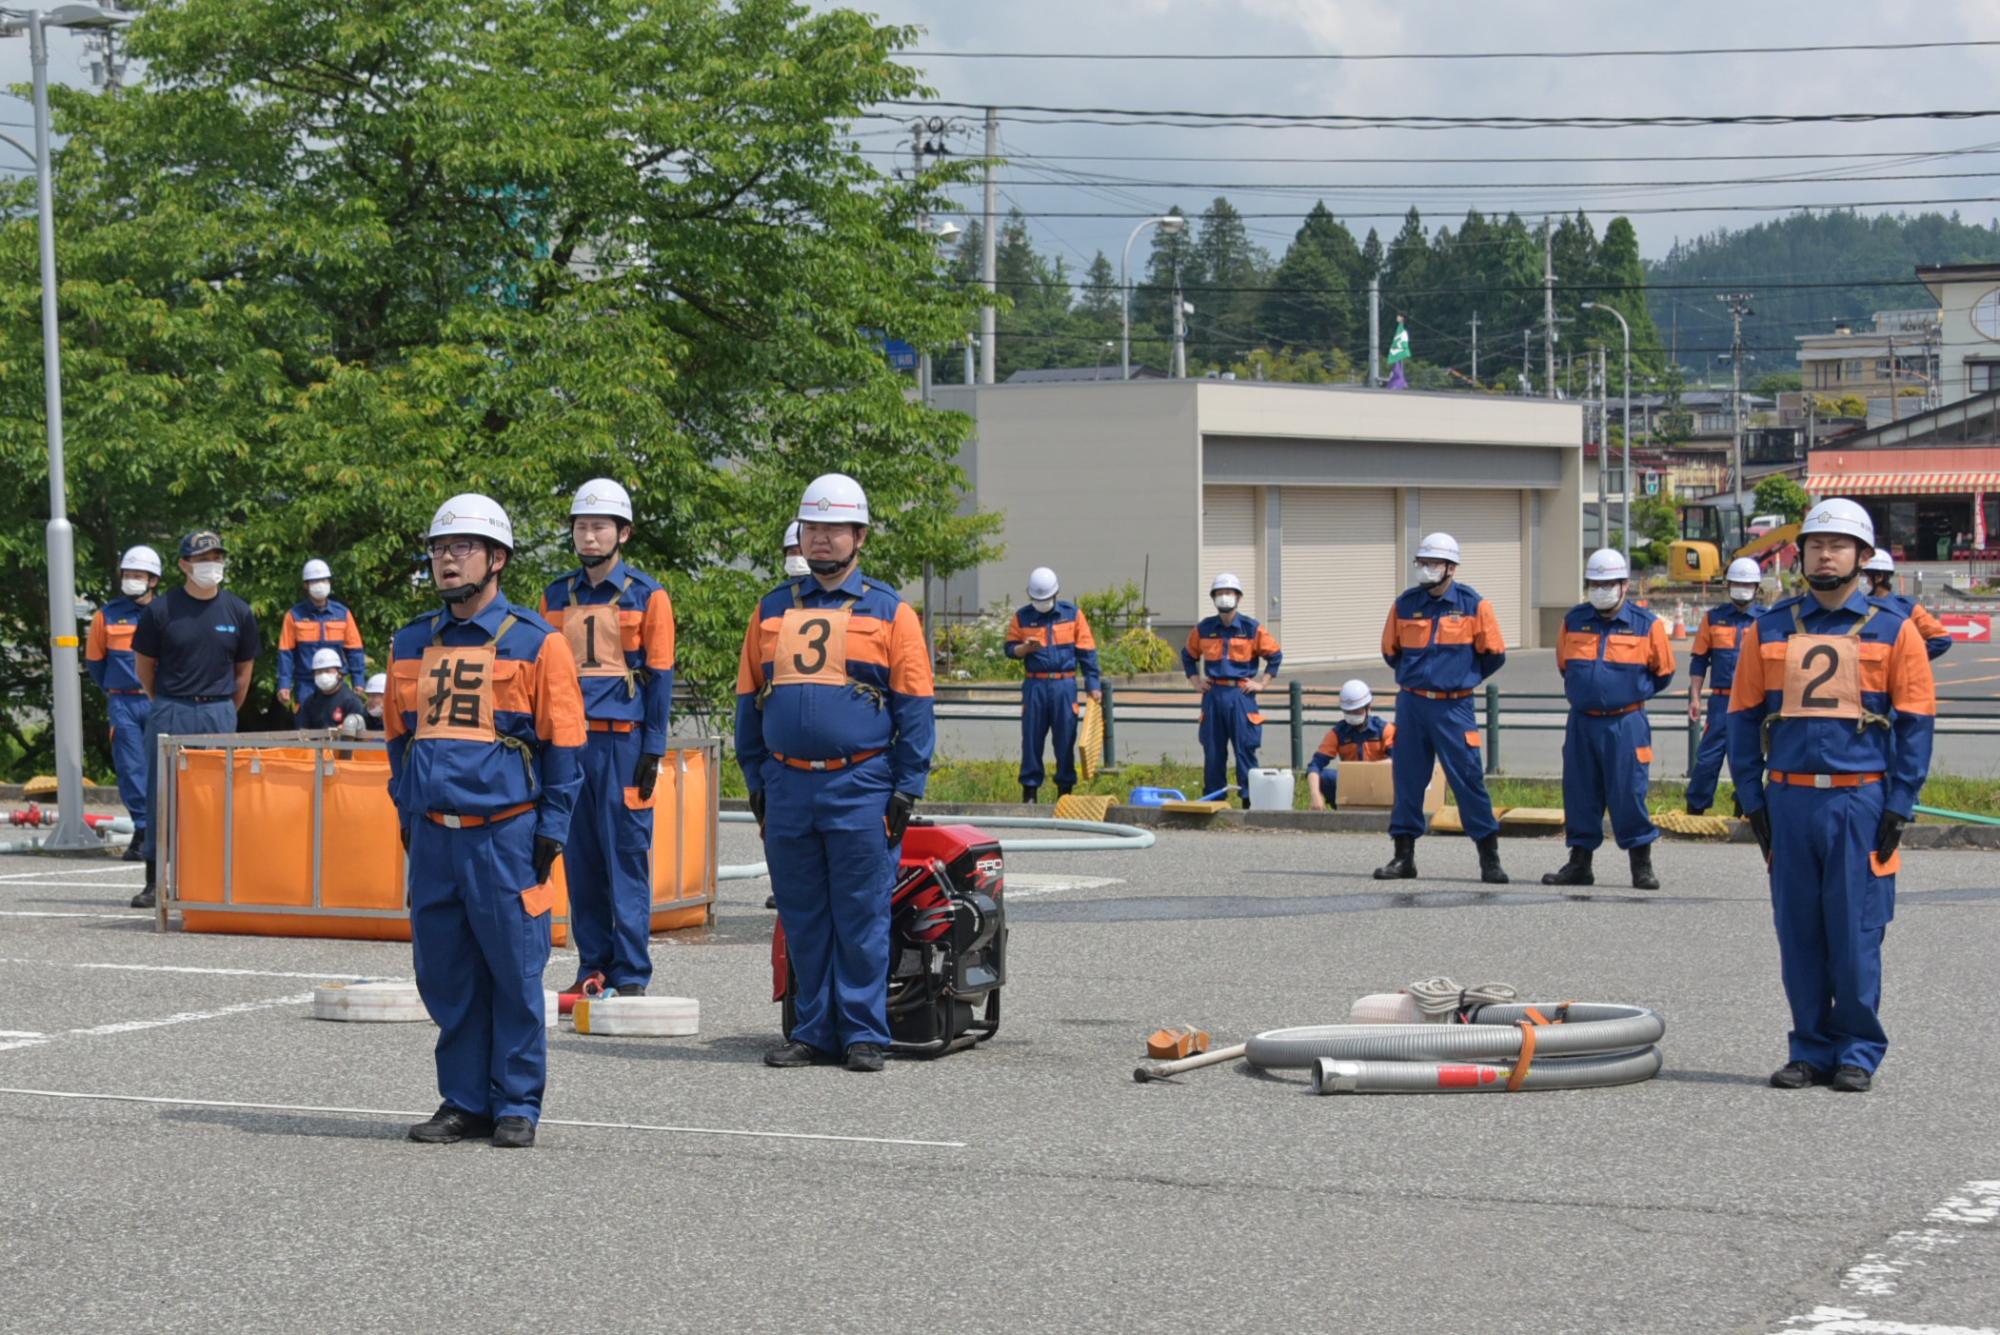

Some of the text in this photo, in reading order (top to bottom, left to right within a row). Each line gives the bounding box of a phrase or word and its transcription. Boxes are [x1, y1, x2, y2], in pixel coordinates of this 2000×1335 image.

[581, 615, 602, 669] 1
[794, 619, 830, 674] 3
[427, 658, 484, 729] 指
[1801, 644, 1838, 707] 2
[976, 859, 1003, 871] PRO
